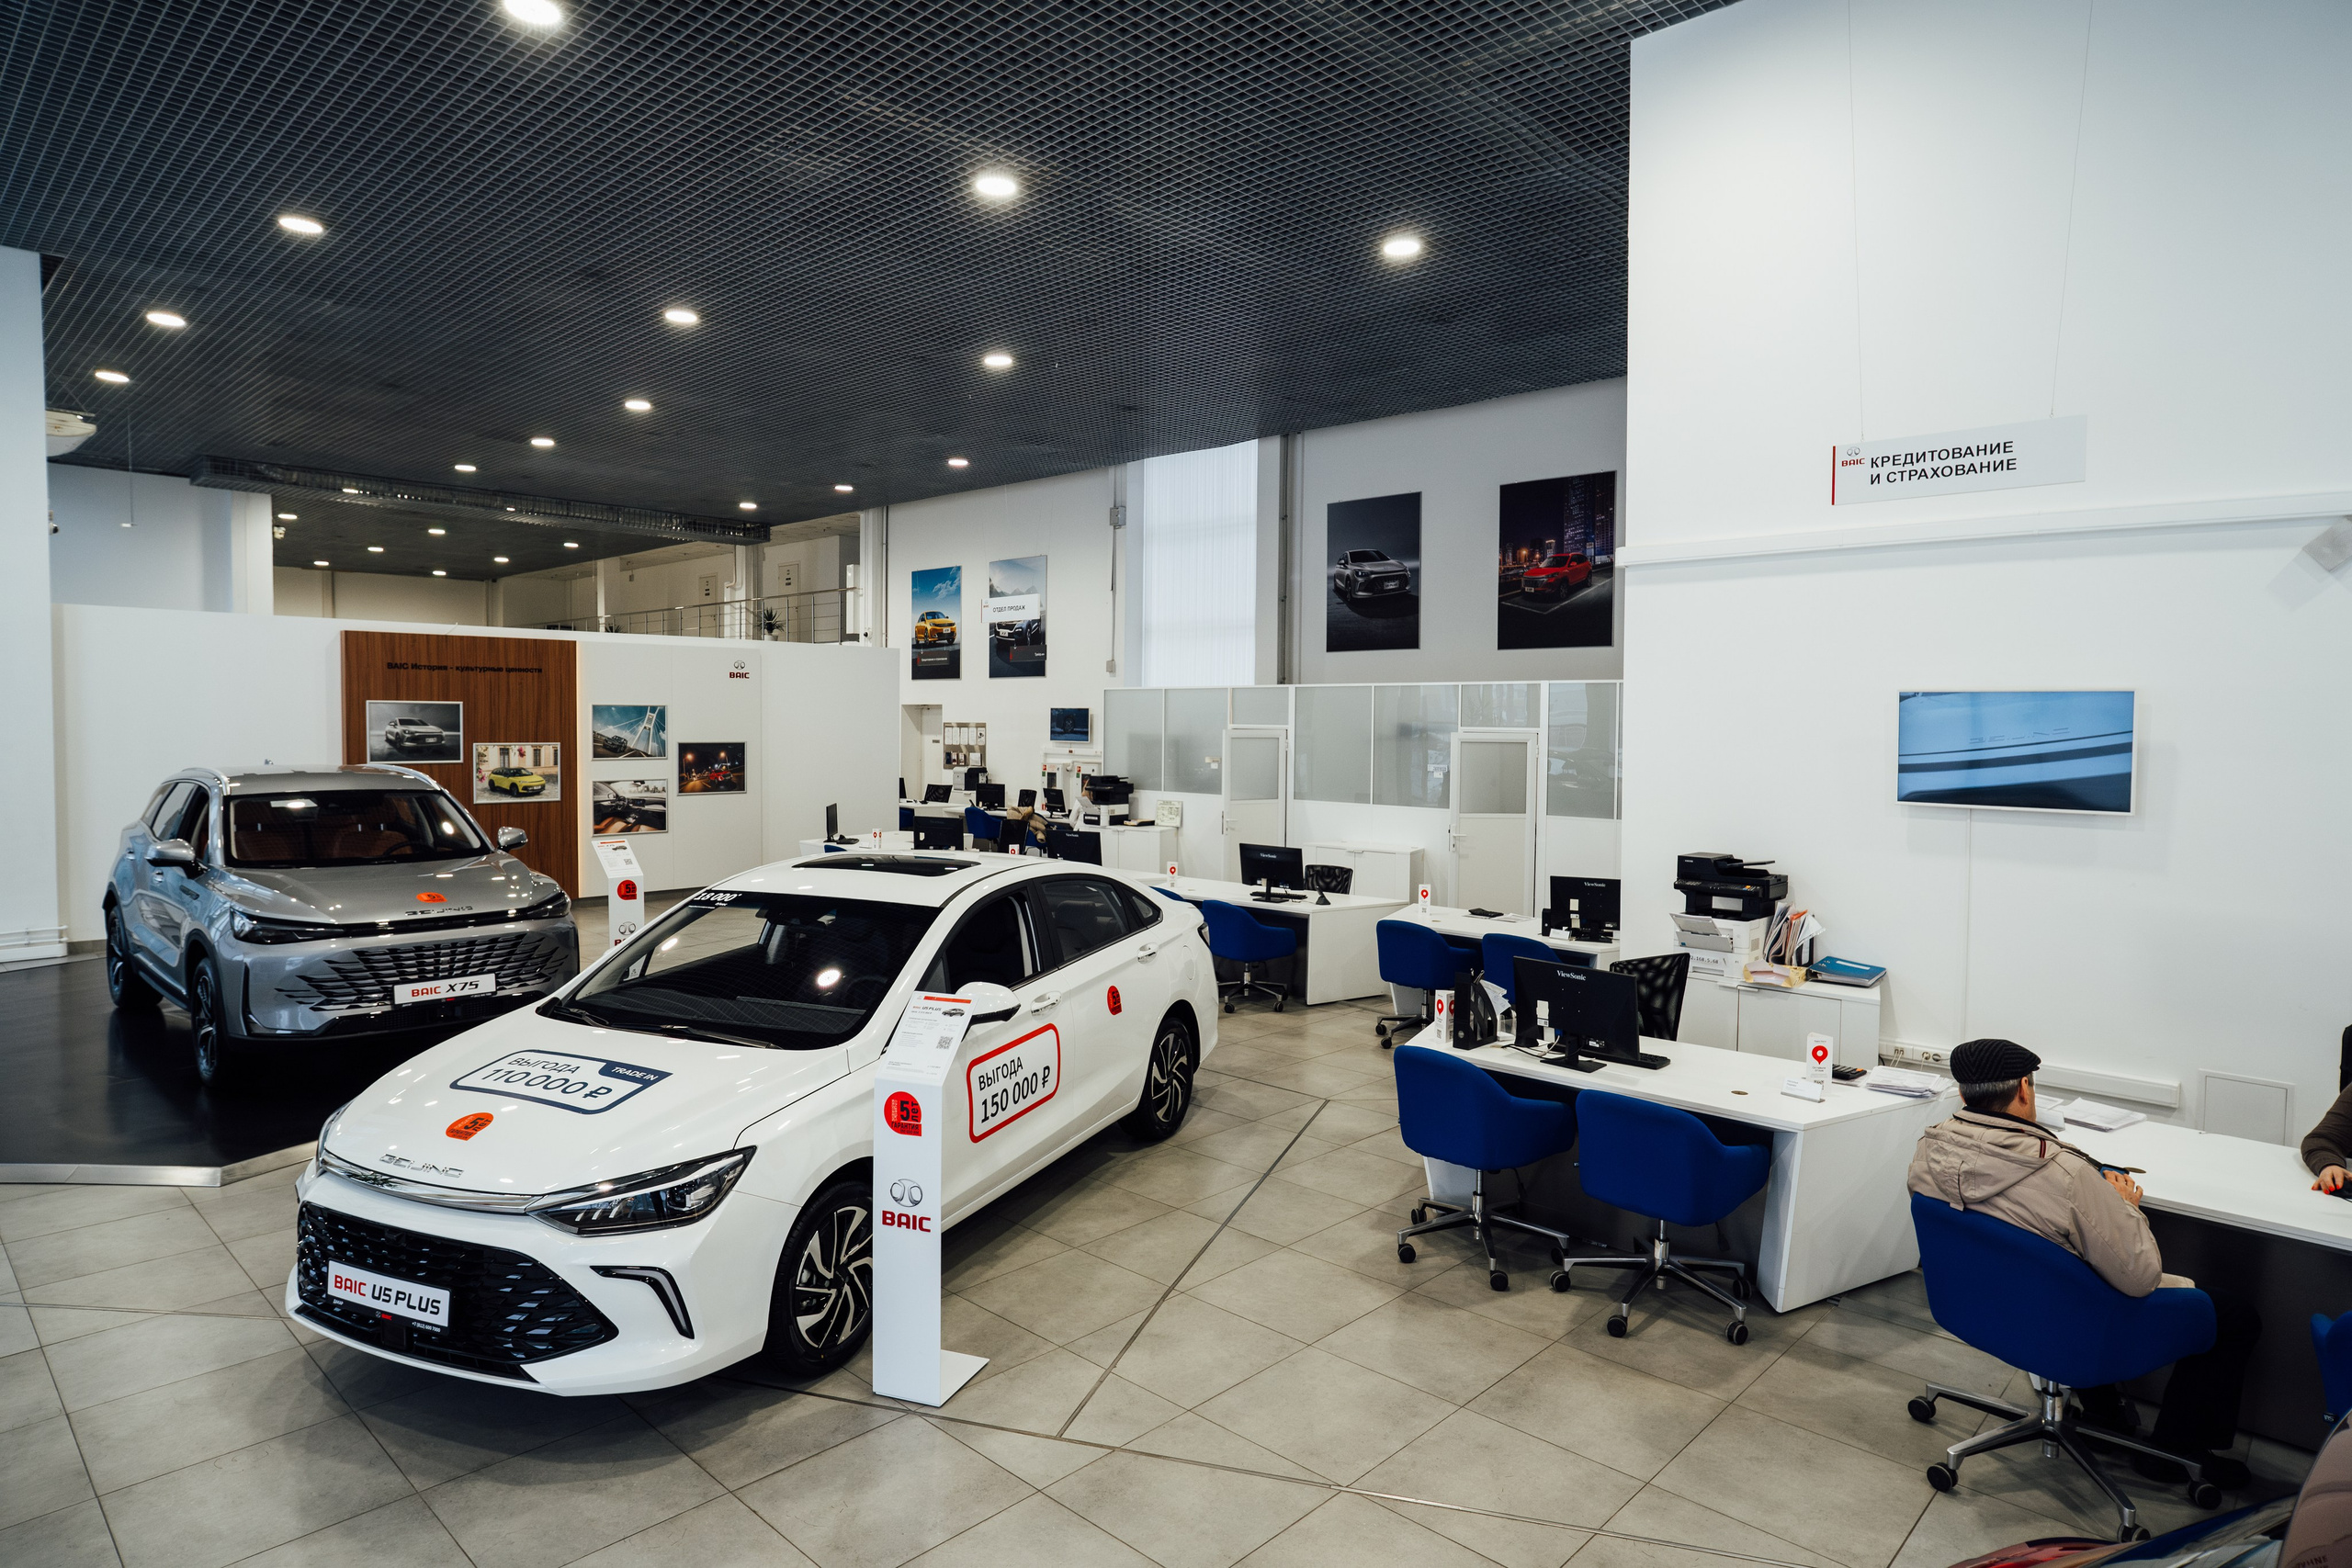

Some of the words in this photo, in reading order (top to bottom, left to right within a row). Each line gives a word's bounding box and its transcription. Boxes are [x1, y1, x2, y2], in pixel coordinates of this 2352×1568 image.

[1841, 457, 1865, 467] BAIC
[1871, 441, 2014, 468] КРЕДИТОВАНИЕ
[1870, 473, 1881, 485] И
[1886, 458, 2017, 483] СТРАХОВАНИЕ
[411, 663, 447, 671] История
[456, 665, 503, 673] культурные
[1690, 956, 1719, 964] 2.168.5.68
[1556, 970, 1587, 981] ViewSonic
[411, 986, 441, 998] BAIC
[446, 980, 480, 993] X75
[507, 1057, 582, 1075] ВЫГОДА
[611, 1066, 647, 1078] TRADE
[643, 1073, 659, 1081] IN
[978, 1056, 1023, 1091] ВЫГОДА
[481, 1068, 520, 1084] 110
[524, 1074, 589, 1095] 000
[980, 1088, 1010, 1123] 150
[1012, 1072, 1038, 1105] 000
[1041, 1065, 1051, 1089] ₽
[900, 1100, 910, 1122] 5
[910, 1101, 919, 1122] лет
[464, 1117, 485, 1130] 5
[891, 1121, 920, 1131] ГАРАНТИЯ
[881, 1210, 932, 1233] BAIC
[334, 1274, 367, 1297] BAIC
[371, 1284, 392, 1303] U5
[394, 1290, 441, 1315] PLUS
